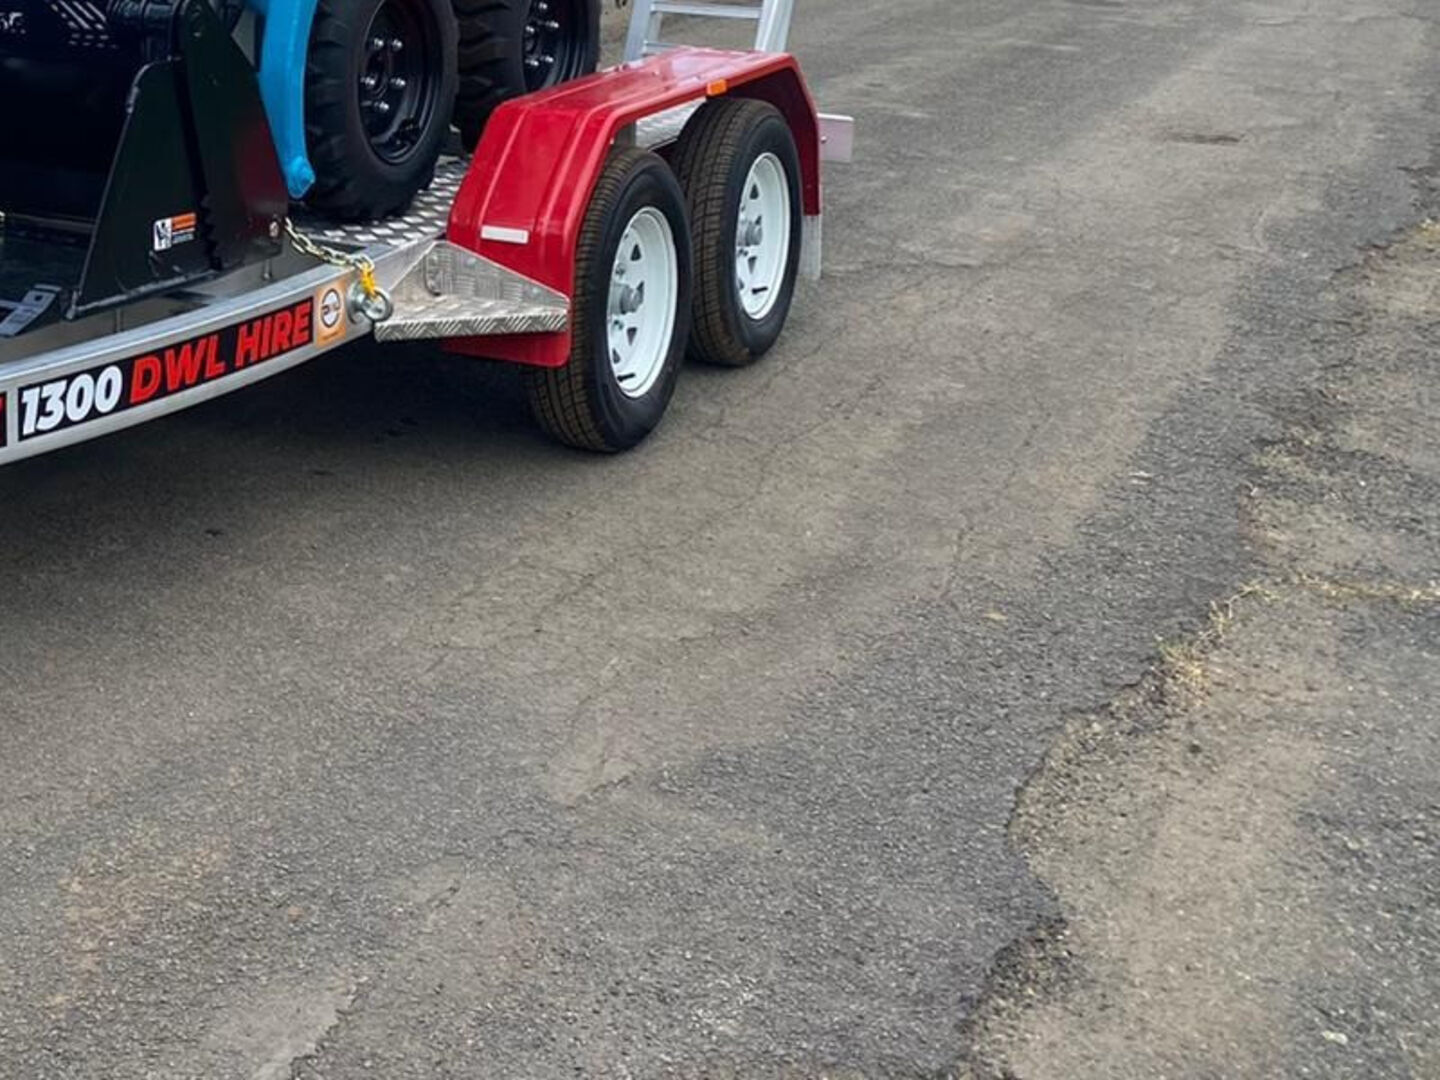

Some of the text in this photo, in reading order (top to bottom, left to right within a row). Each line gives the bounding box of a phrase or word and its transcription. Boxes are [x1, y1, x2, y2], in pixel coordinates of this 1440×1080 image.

[21, 304, 312, 436] 1300 DWL HIRE
